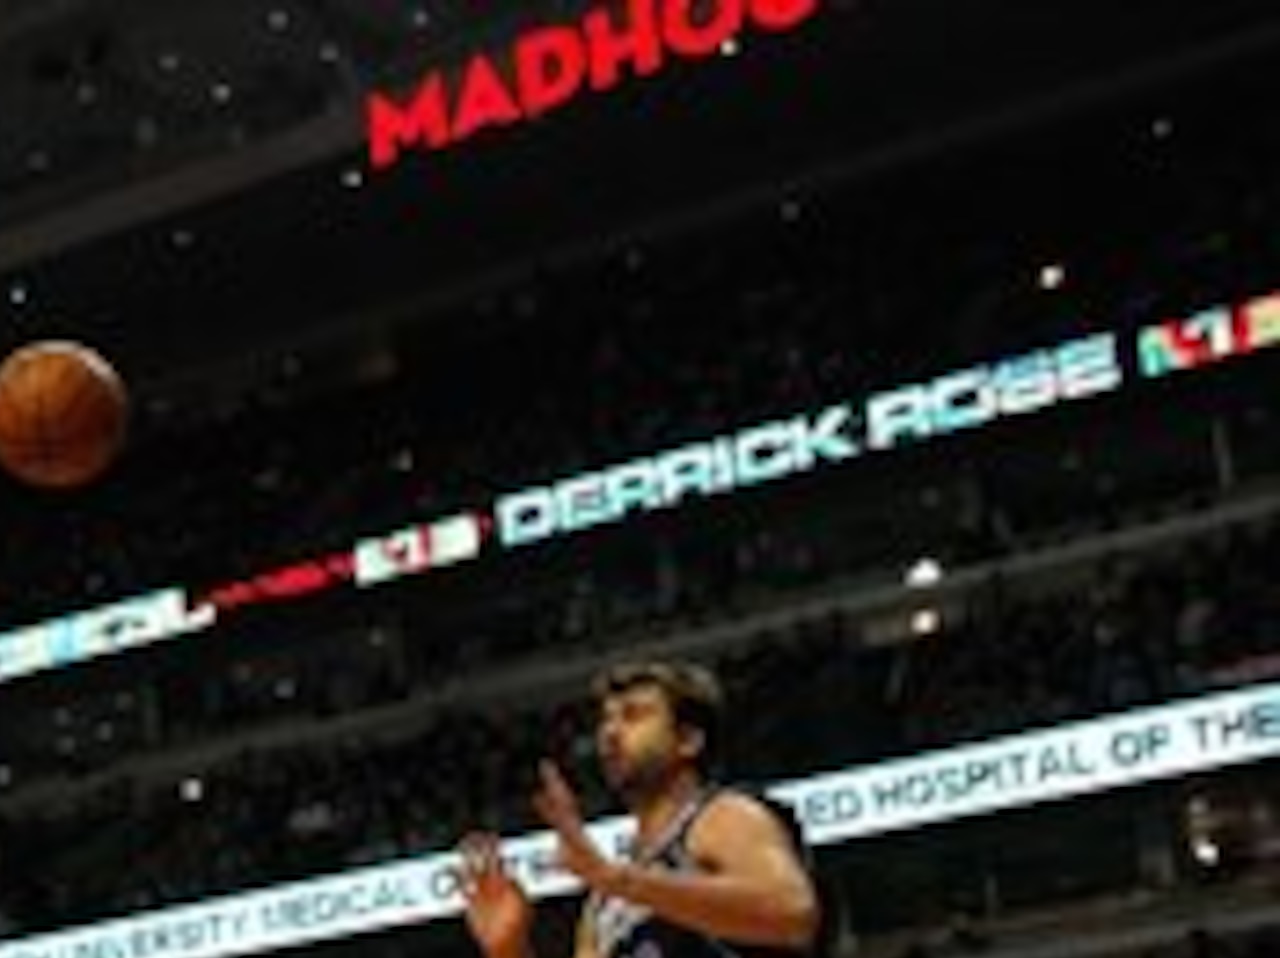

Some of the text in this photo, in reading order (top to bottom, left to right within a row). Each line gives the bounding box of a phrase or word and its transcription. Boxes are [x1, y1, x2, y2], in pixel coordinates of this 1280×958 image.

[495, 403, 860, 547] DERRICK
[866, 330, 1121, 450] ROSE
[260, 874, 417, 934] MEDICAL
[871, 741, 1096, 813] HOSPITAL
[1110, 721, 1172, 768] OF
[1190, 698, 1280, 750] THE
